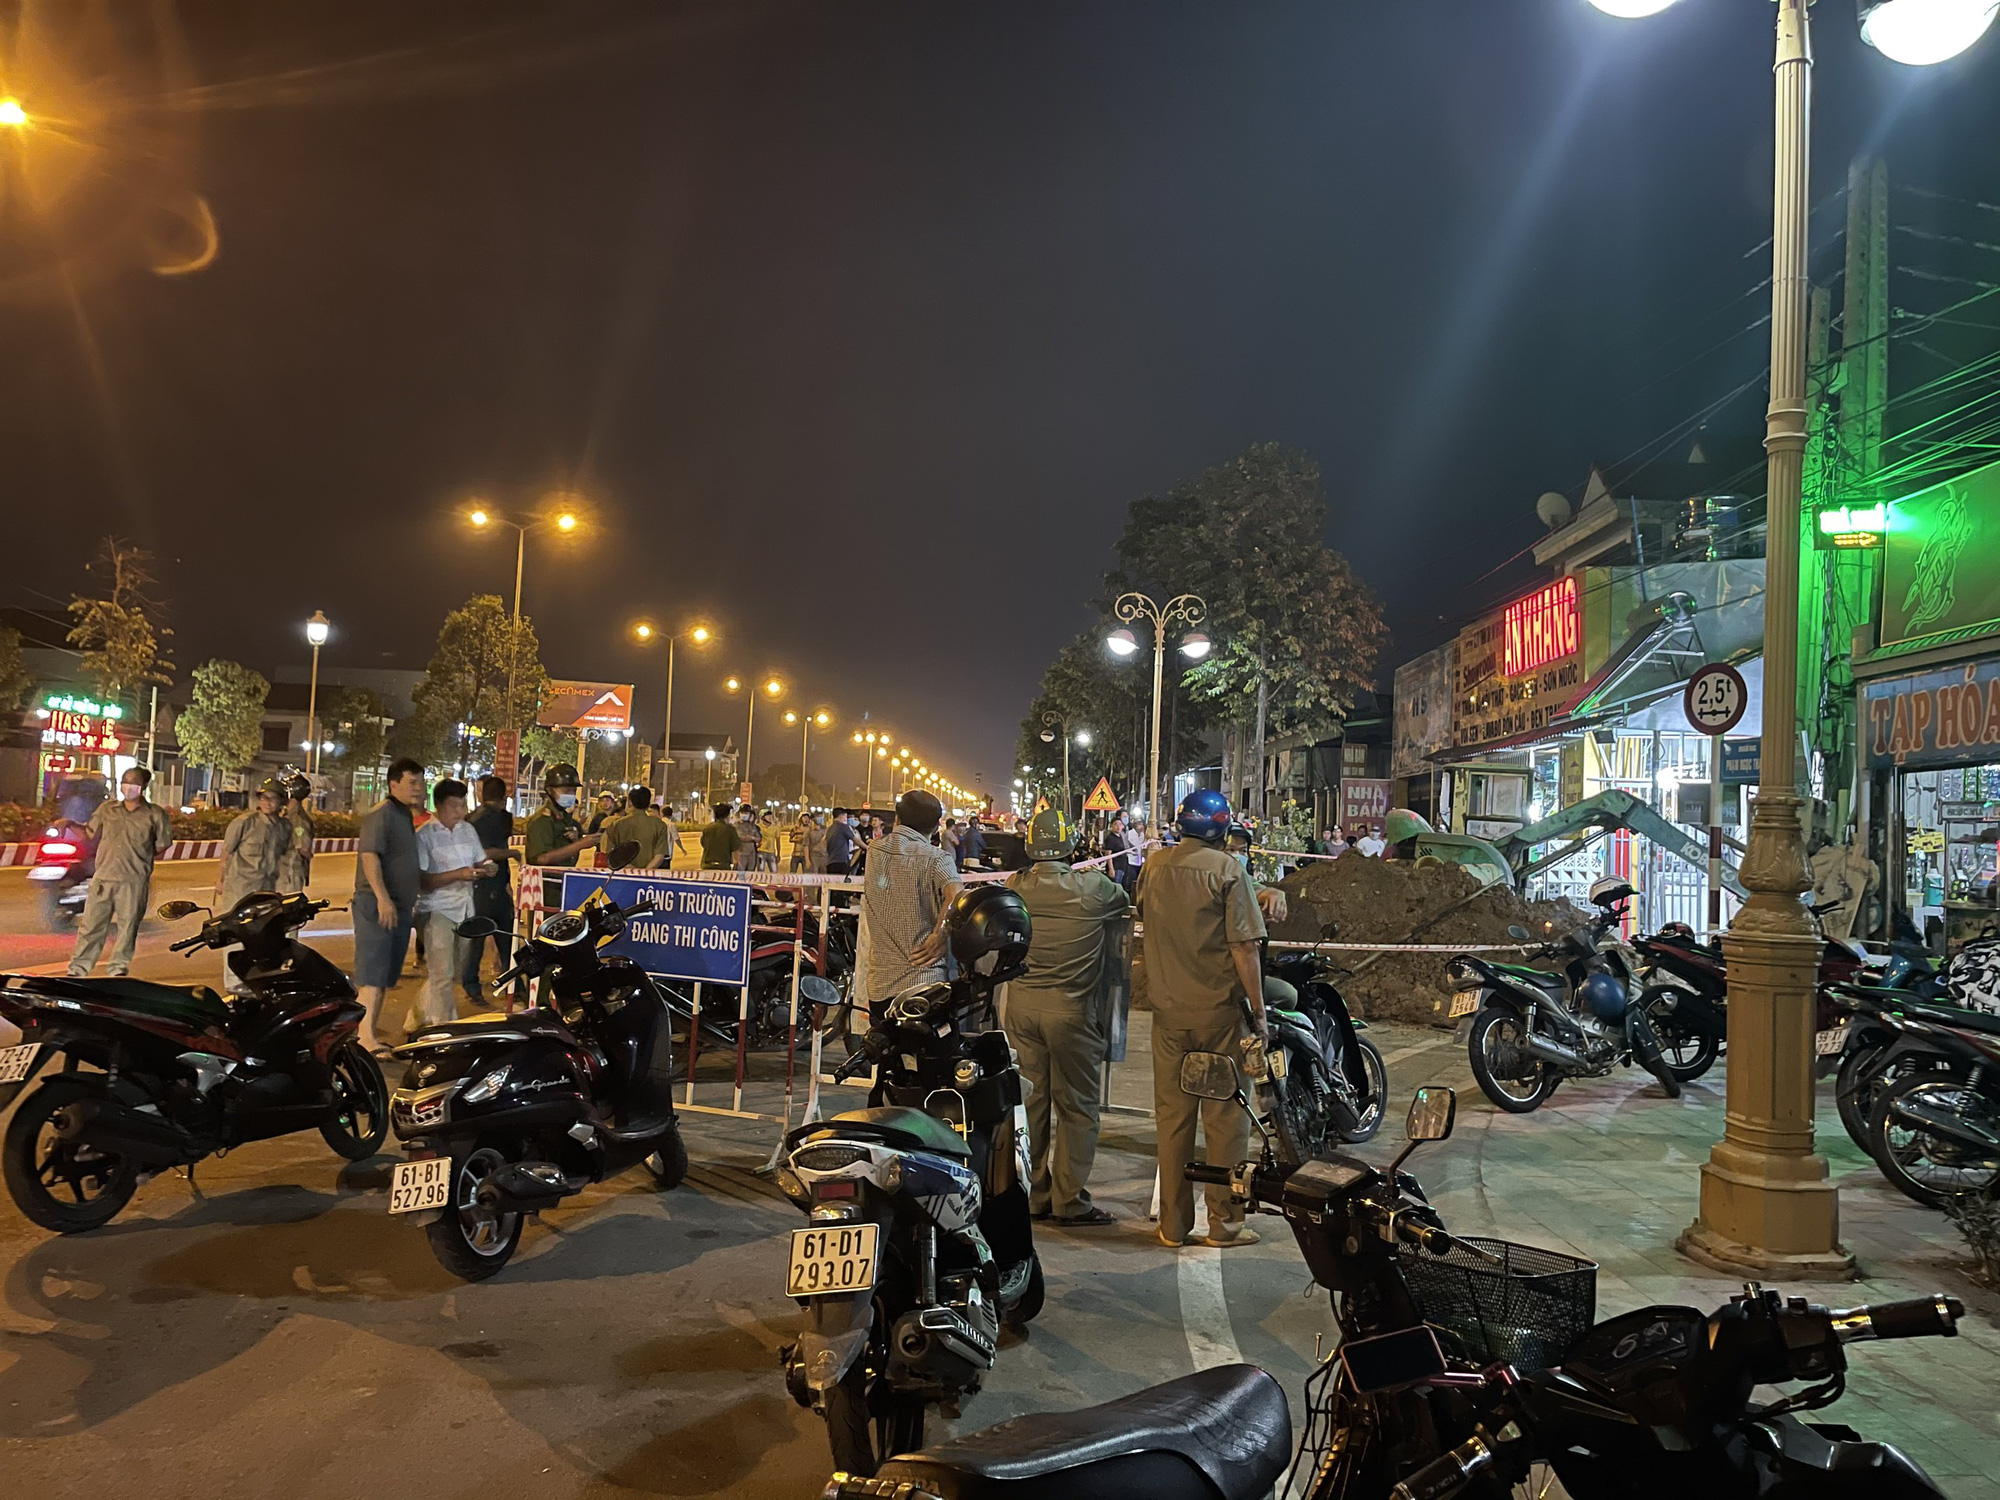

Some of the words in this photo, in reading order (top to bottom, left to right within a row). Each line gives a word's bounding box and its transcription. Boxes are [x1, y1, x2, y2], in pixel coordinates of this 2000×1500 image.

[1504, 603, 1522, 677] AN
[1522, 576, 1578, 670] KHANG
[1871, 689, 1932, 765] TẠP
[1936, 663, 2000, 750] HÓA
[1347, 783, 1384, 800] NHÀ
[1347, 802, 1385, 818] BÁN
[636, 885, 674, 912] CÔNG
[679, 888, 736, 917] TRƯỜNG
[631, 921, 669, 945] ĐANG
[673, 924, 696, 948] THI
[700, 924, 739, 952] CÔNG
[401, 1162, 441, 1187] 61-B1
[393, 1183, 445, 1209] 527.96
[803, 1229, 862, 1260] 61-D1
[792, 1258, 870, 1290] 293.07
